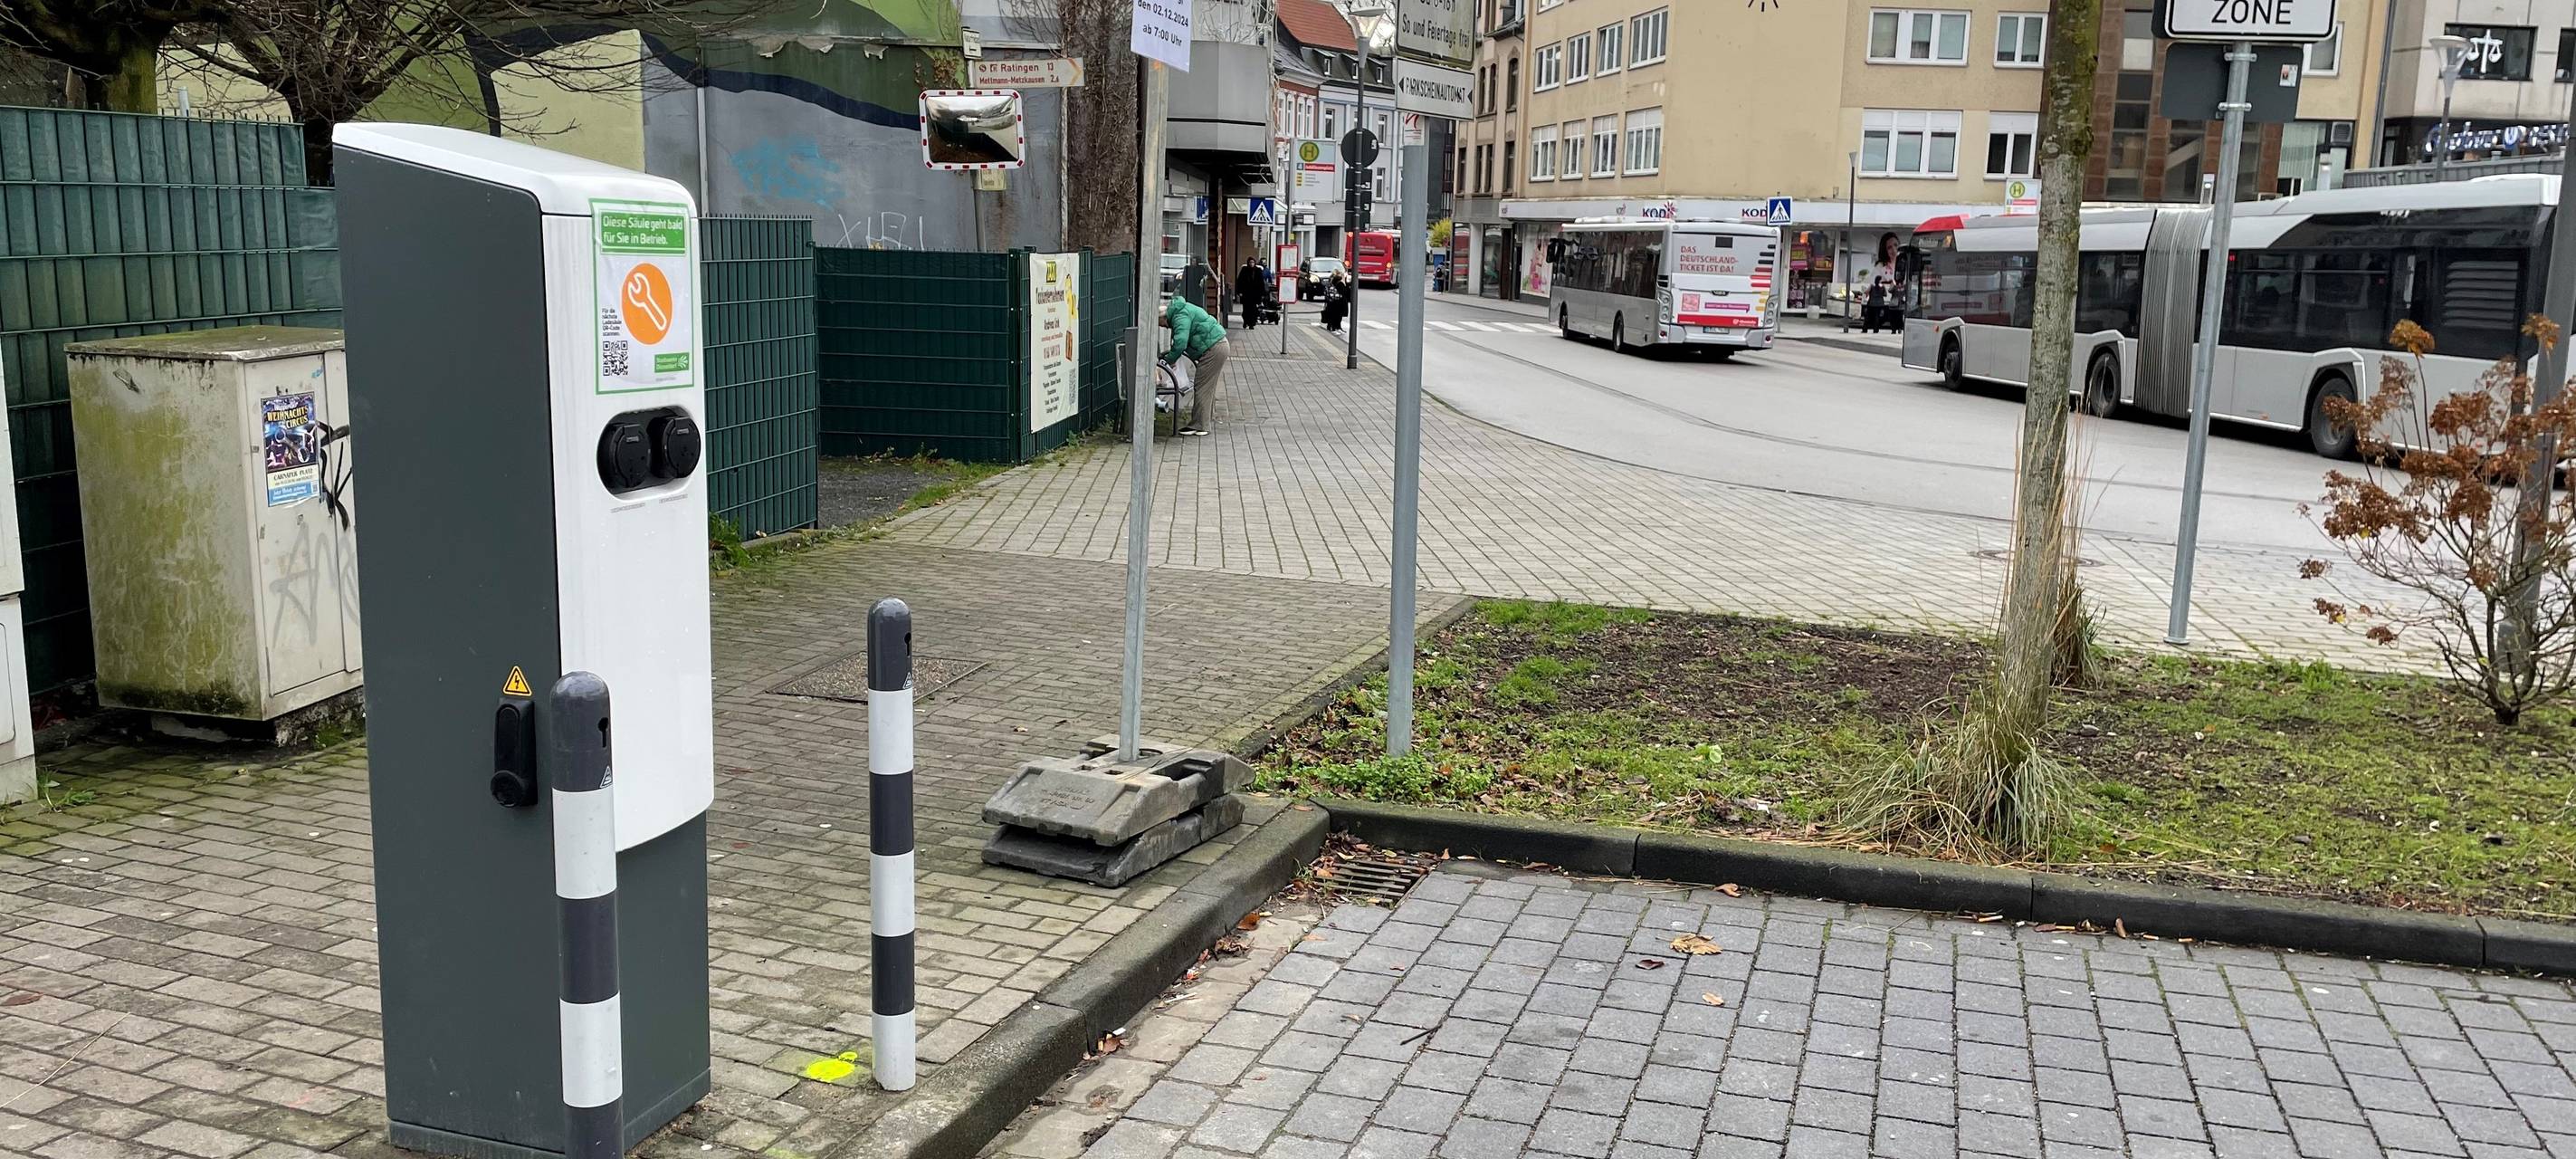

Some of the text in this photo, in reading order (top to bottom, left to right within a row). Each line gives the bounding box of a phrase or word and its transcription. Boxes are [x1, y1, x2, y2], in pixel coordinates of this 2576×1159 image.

[1137, 0, 1188, 27] den 02.12.2024
[2211, 0, 2294, 24] ZONE
[1143, 24, 1182, 46] ab 7:00 Uhr
[1402, 14, 1470, 49] So und Feiertage frei
[1001, 62, 1054, 73] Ratingen 13
[1407, 77, 1465, 103] PARKSCHEINAUTOMAT
[1741, 208, 1767, 218] KOD
[603, 216, 682, 231] Diese Säule geht bald
[603, 232, 668, 244] für Sie in Betrieb.
[1680, 254, 1739, 263] DEUTSCHLAND-
[267, 406, 308, 422] WEIHNACHTS
[286, 415, 308, 429] CIRCUS
